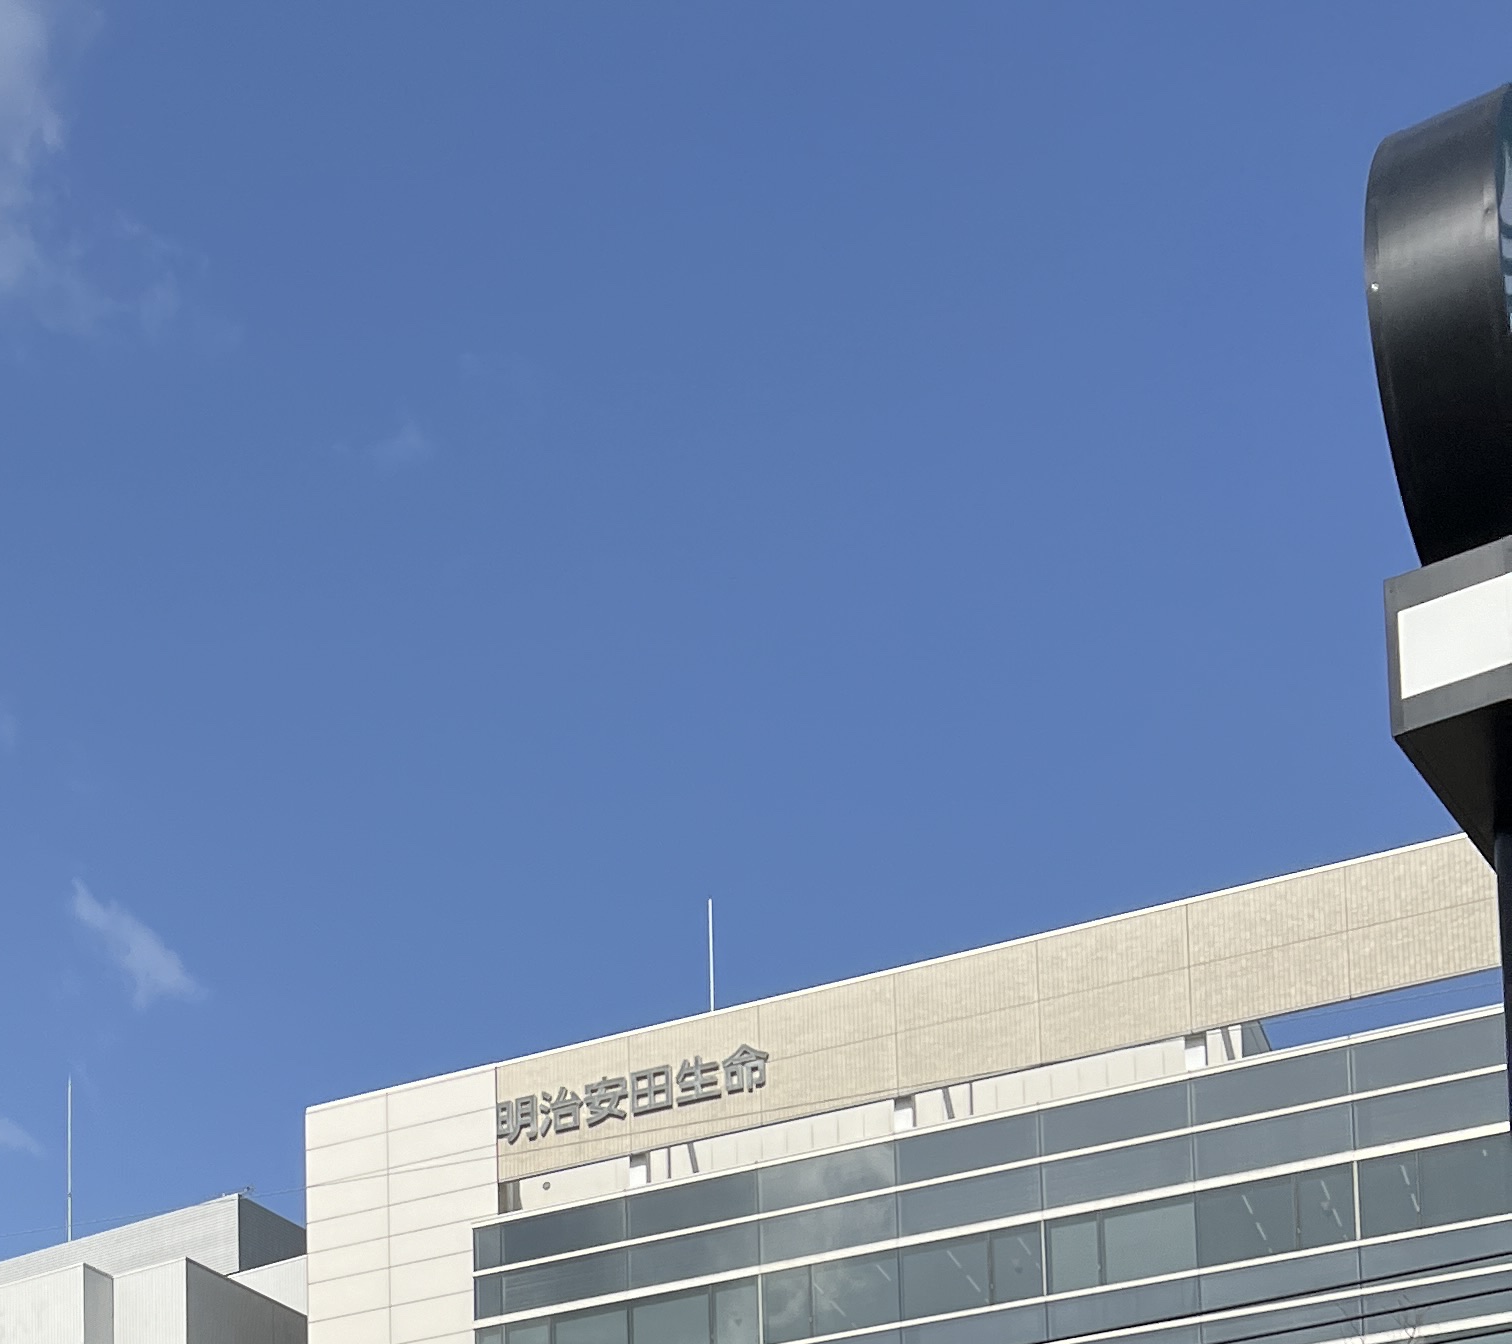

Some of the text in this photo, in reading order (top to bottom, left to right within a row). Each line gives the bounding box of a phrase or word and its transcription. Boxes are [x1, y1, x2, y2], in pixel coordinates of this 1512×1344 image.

[497, 1043, 769, 1145] 明治安田生命
